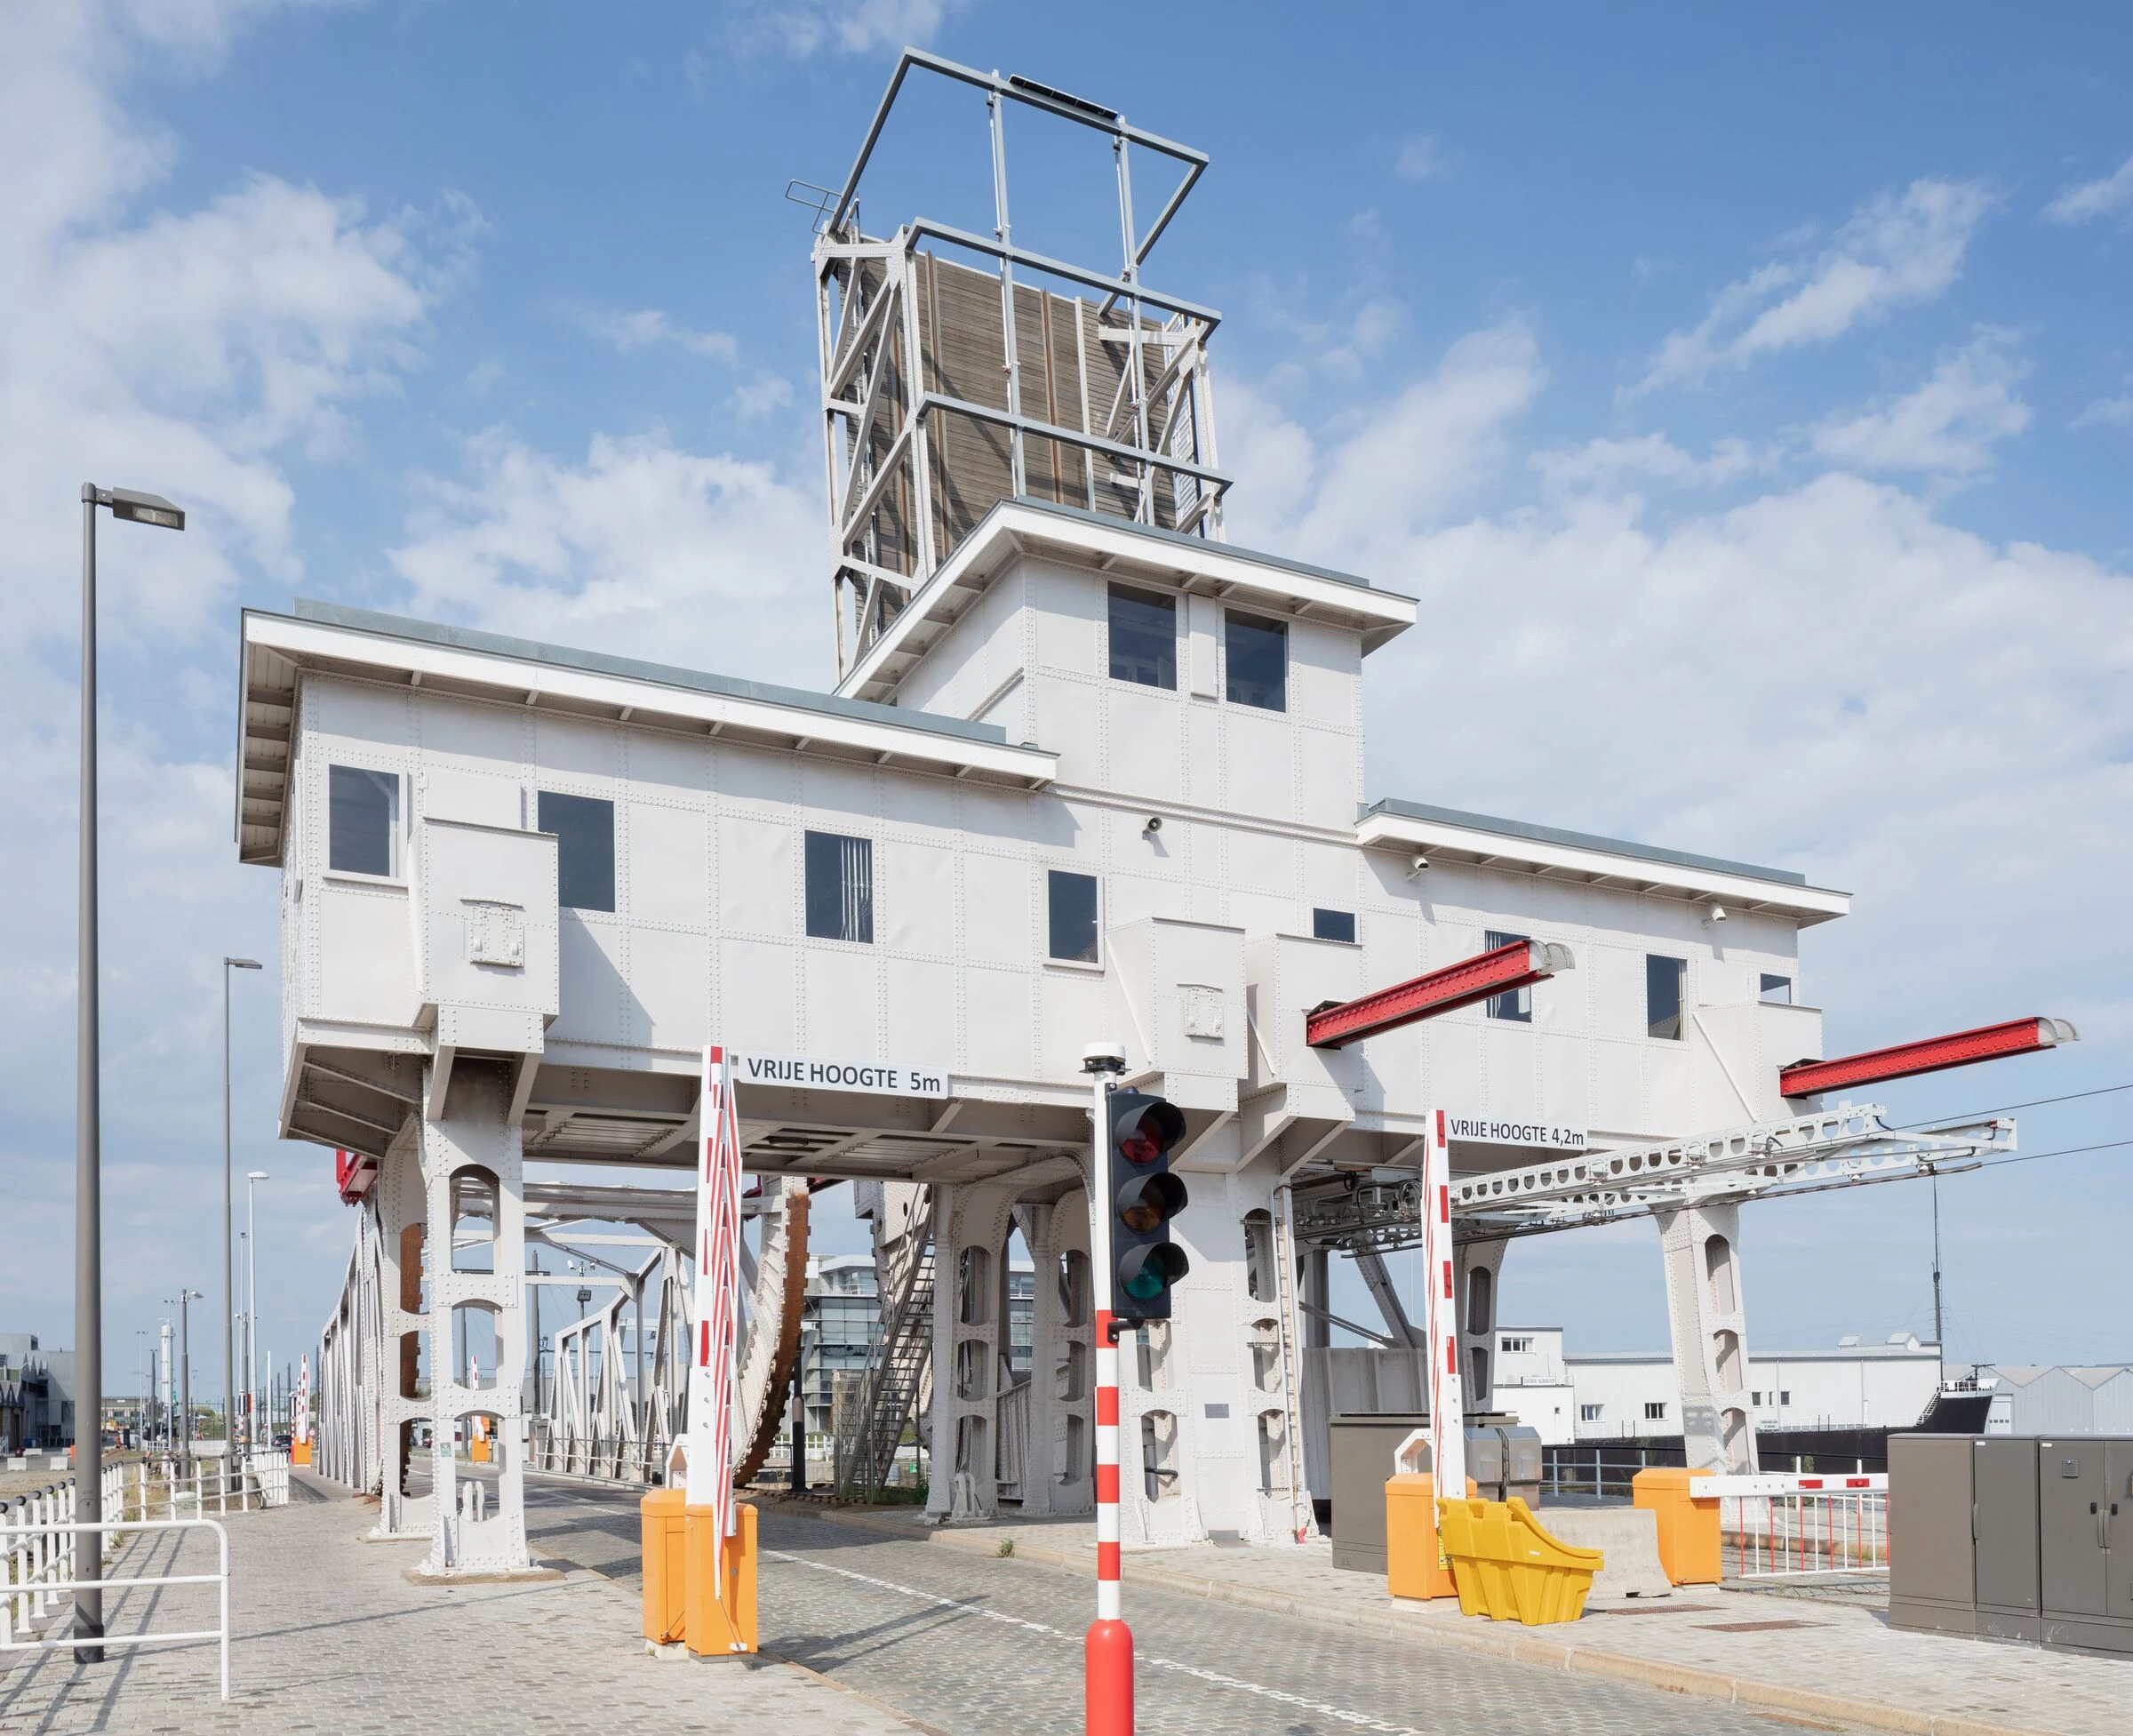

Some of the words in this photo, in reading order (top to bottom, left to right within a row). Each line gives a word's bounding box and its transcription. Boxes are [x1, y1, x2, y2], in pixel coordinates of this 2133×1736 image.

[747, 1058, 804, 1081] VRIJE
[810, 1063, 898, 1088] HOOGTE
[910, 1072, 940, 1092] 5m
[1450, 1119, 1487, 1137] VRIJE
[1490, 1123, 1547, 1142] HOOGTE
[1552, 1128, 1584, 1147] 4,2m
